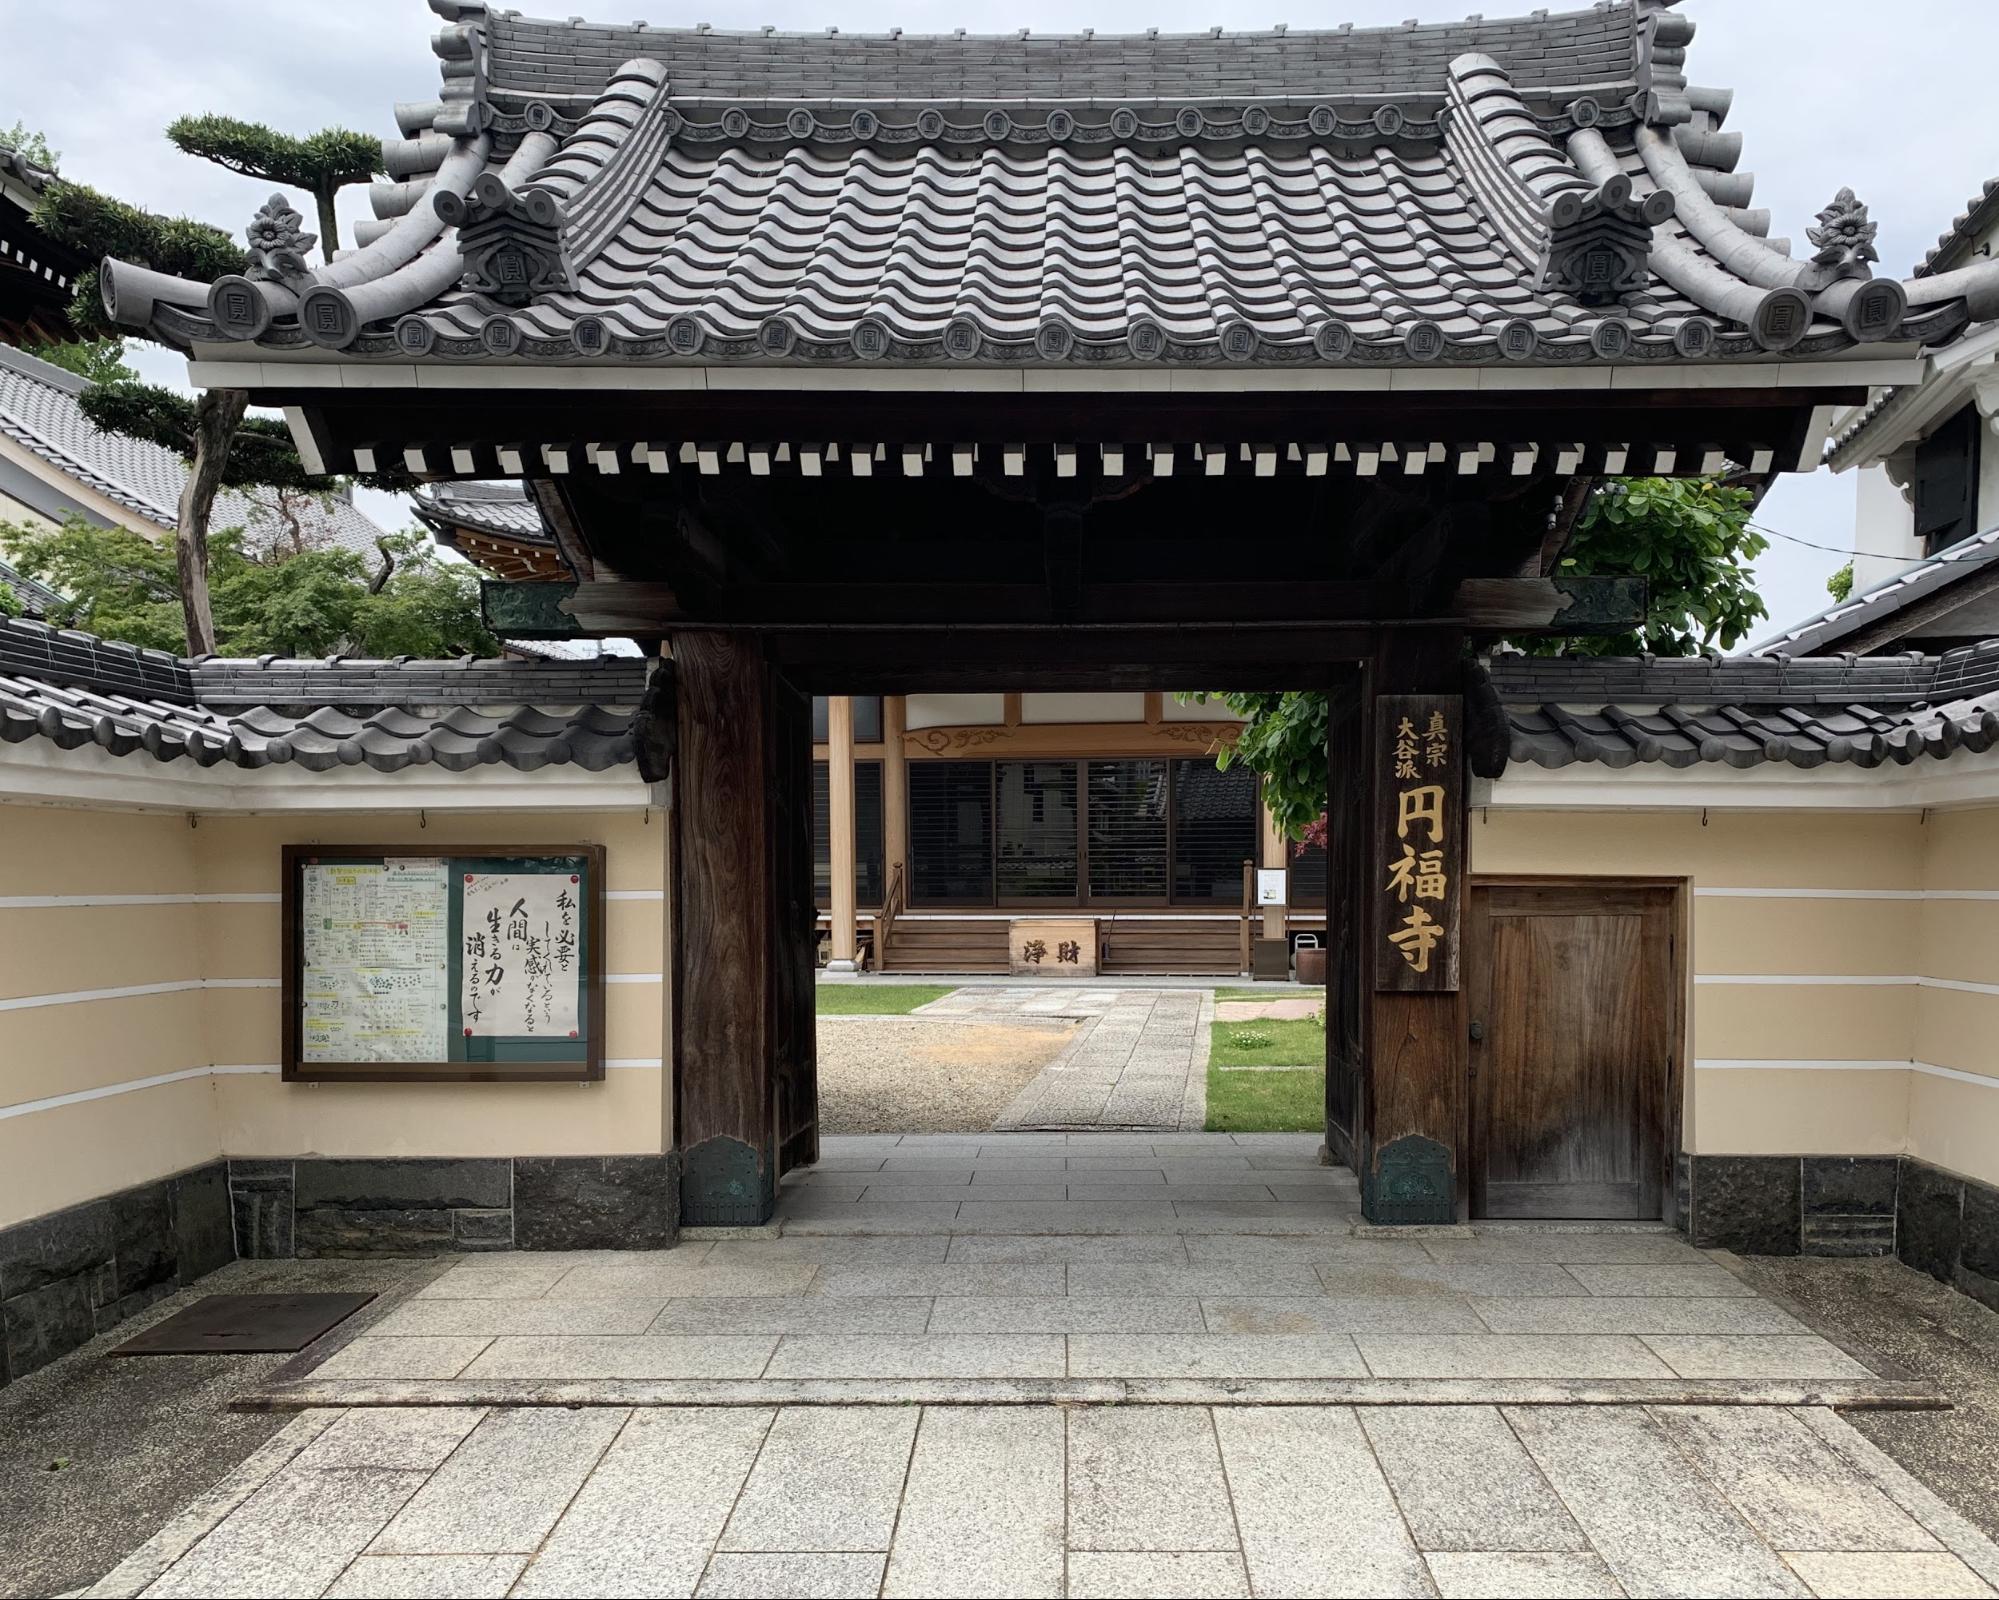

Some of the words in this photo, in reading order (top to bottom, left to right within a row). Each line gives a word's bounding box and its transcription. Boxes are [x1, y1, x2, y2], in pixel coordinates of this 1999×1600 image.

[1391, 716, 1421, 779] 大谷派
[1422, 711, 1448, 768] 真宗
[1384, 785, 1448, 973] 円福寺
[485, 907, 505, 997] 生きる力が
[507, 897, 529, 951] 人間は
[553, 889, 577, 972] 私を必要と
[465, 932, 486, 1024] 消えるのです
